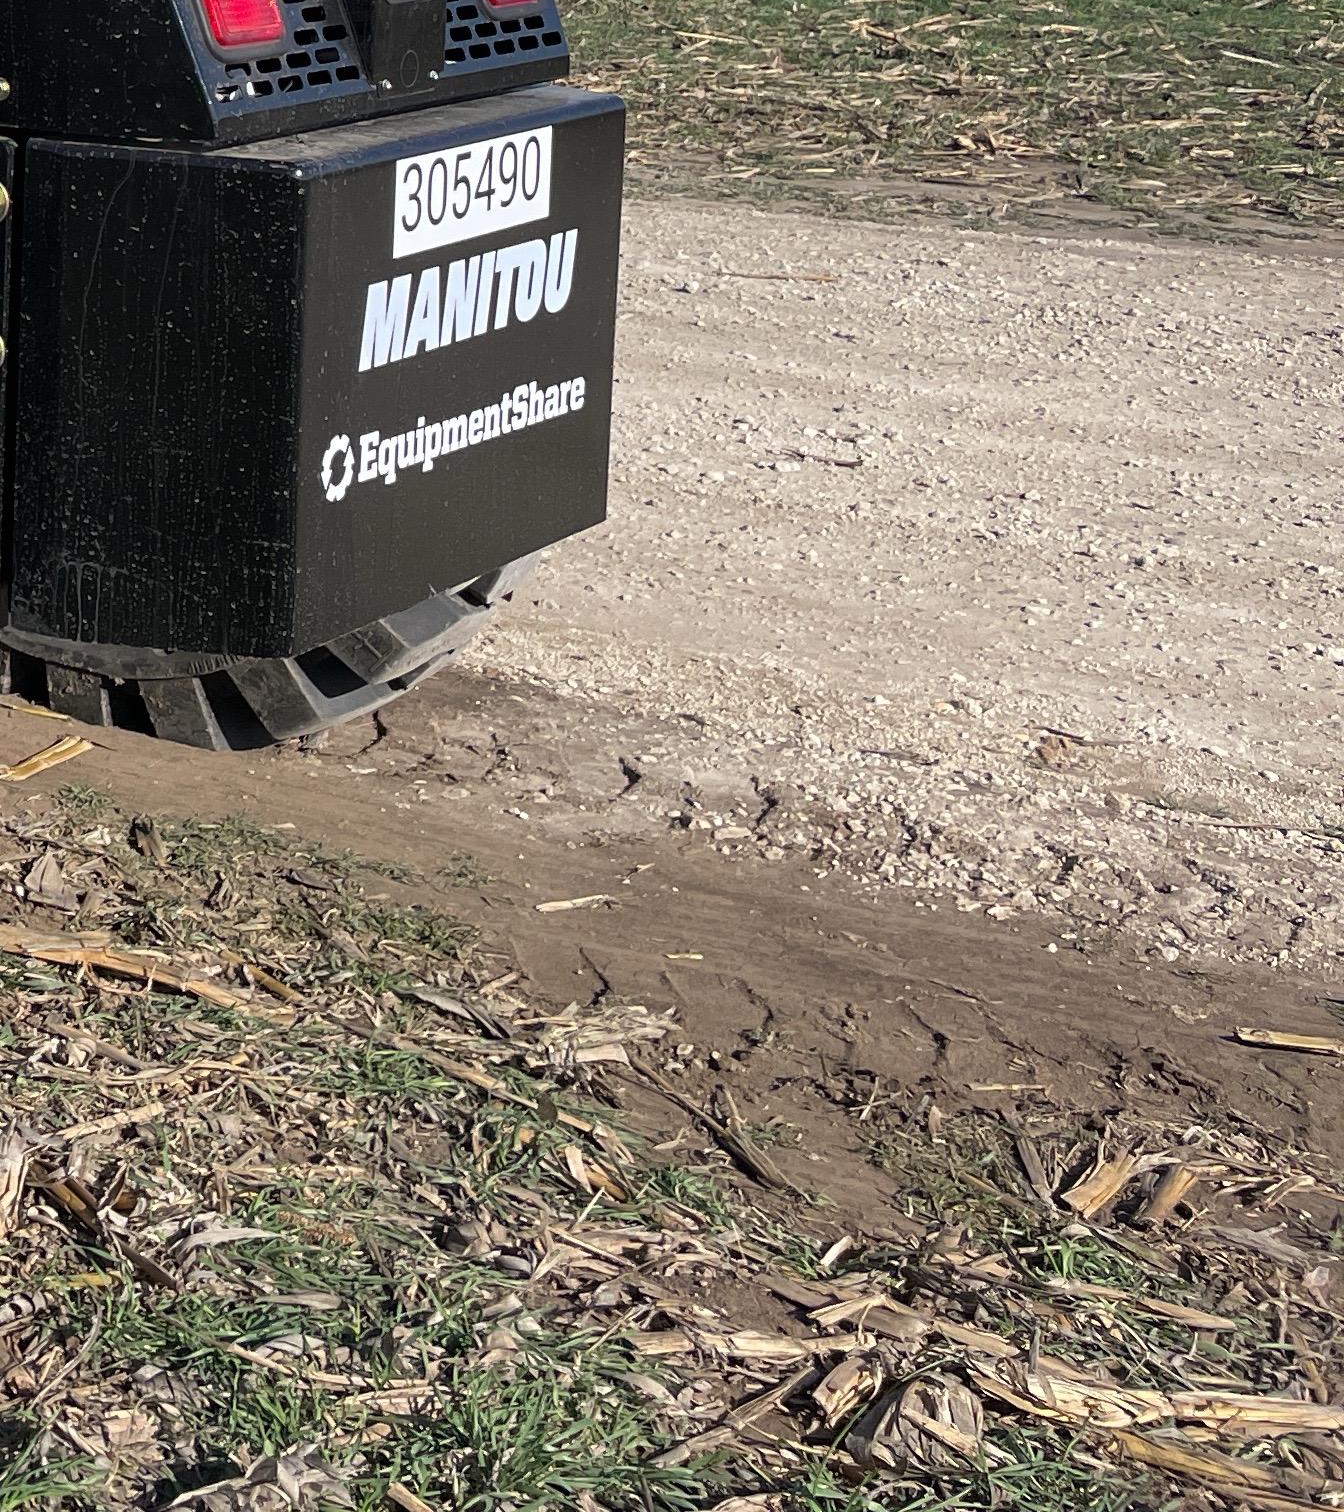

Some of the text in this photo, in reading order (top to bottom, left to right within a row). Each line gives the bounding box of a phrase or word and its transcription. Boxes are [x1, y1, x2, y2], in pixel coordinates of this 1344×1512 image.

[401, 135, 541, 233] 305490
[358, 228, 579, 373] MANITOU
[357, 376, 586, 486] EquipmentShare
